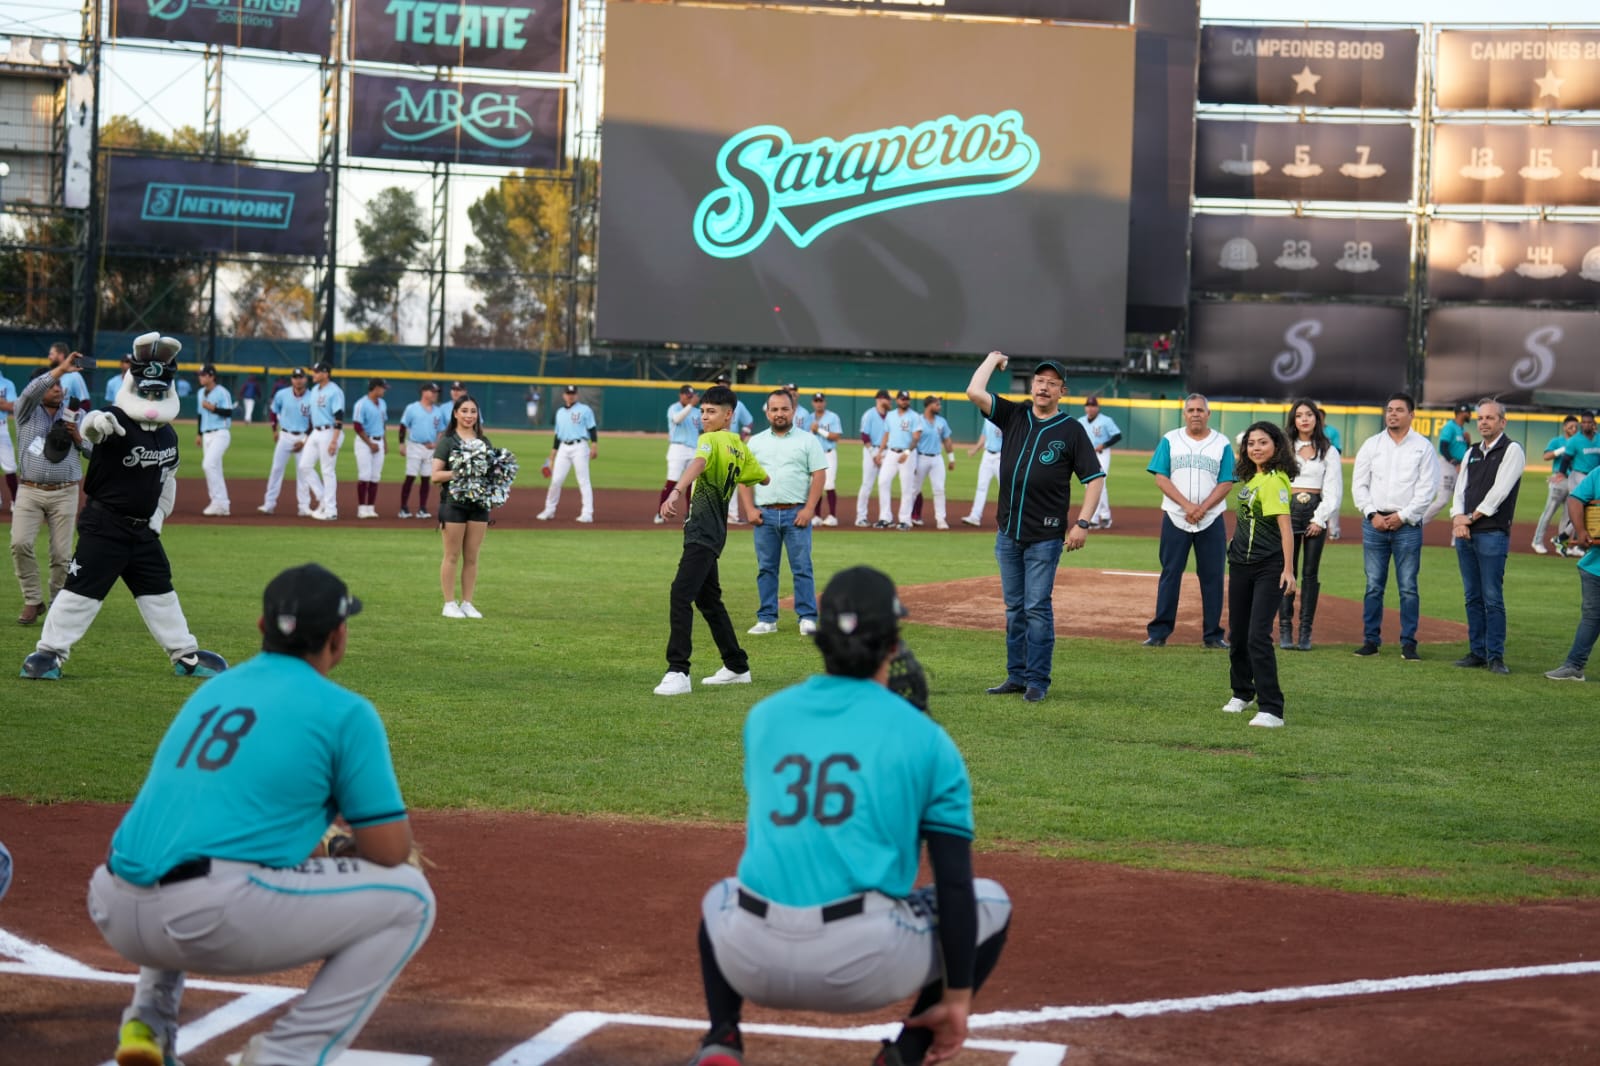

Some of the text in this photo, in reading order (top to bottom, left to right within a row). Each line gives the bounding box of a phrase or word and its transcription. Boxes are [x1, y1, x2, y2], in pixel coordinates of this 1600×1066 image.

[216, 11, 273, 28] Solutions
[384, 0, 533, 50] TECATE
[1231, 38, 1384, 60] CAMPEONES 2009
[1470, 42, 1582, 61] CAMPEONES
[394, 86, 520, 129] MRCI
[1294, 144, 1311, 167] 5
[1355, 145, 1371, 167] 7
[1529, 147, 1553, 168] 15
[693, 109, 1041, 259] Saraperos
[181, 195, 285, 220] NETWORK
[1526, 245, 1554, 267] 44
[1271, 319, 1322, 383] S
[1511, 325, 1564, 389] S
[175, 704, 258, 772] 18
[769, 753, 861, 826] 36
